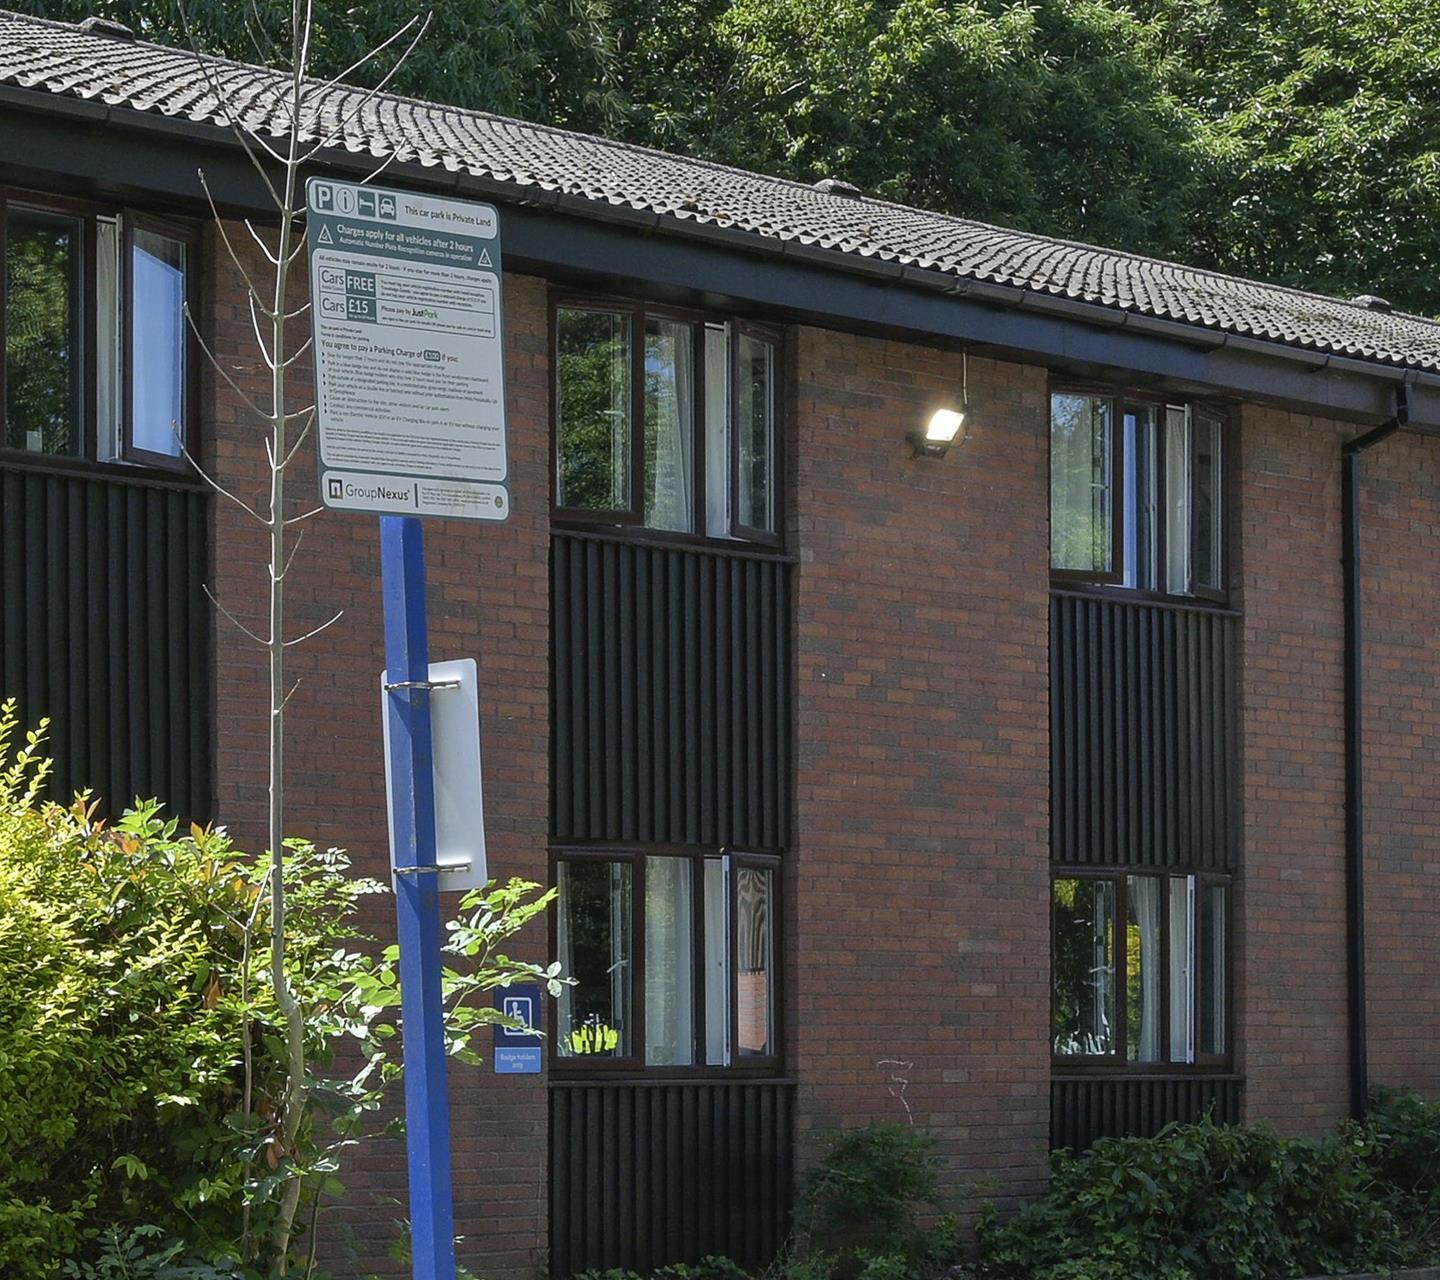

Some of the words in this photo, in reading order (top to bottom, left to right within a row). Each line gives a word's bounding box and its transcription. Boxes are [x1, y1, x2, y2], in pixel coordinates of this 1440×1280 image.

[405, 206, 418, 216] This
[420, 210, 429, 218] car
[430, 210, 445, 221] park
[446, 212, 451, 220] is
[452, 214, 474, 225] Private
[476, 218, 491, 227] Land
[337, 224, 364, 238] Charges
[366, 228, 384, 240] apply
[386, 230, 395, 240] for
[396, 232, 404, 242] all
[406, 233, 431, 246] vehicles
[432, 237, 448, 248] after
[450, 240, 454, 249] 2
[455, 241, 474, 252] hours
[322, 270, 344, 286] Cars
[347, 276, 374, 292] FREE
[322, 298, 345, 312] Cars
[348, 300, 368, 314] £15
[321, 339, 332, 347] You
[334, 342, 348, 350] agree
[374, 345, 394, 356] Parking
[395, 348, 414, 358] Charge
[346, 484, 408, 500] GroupNexus
